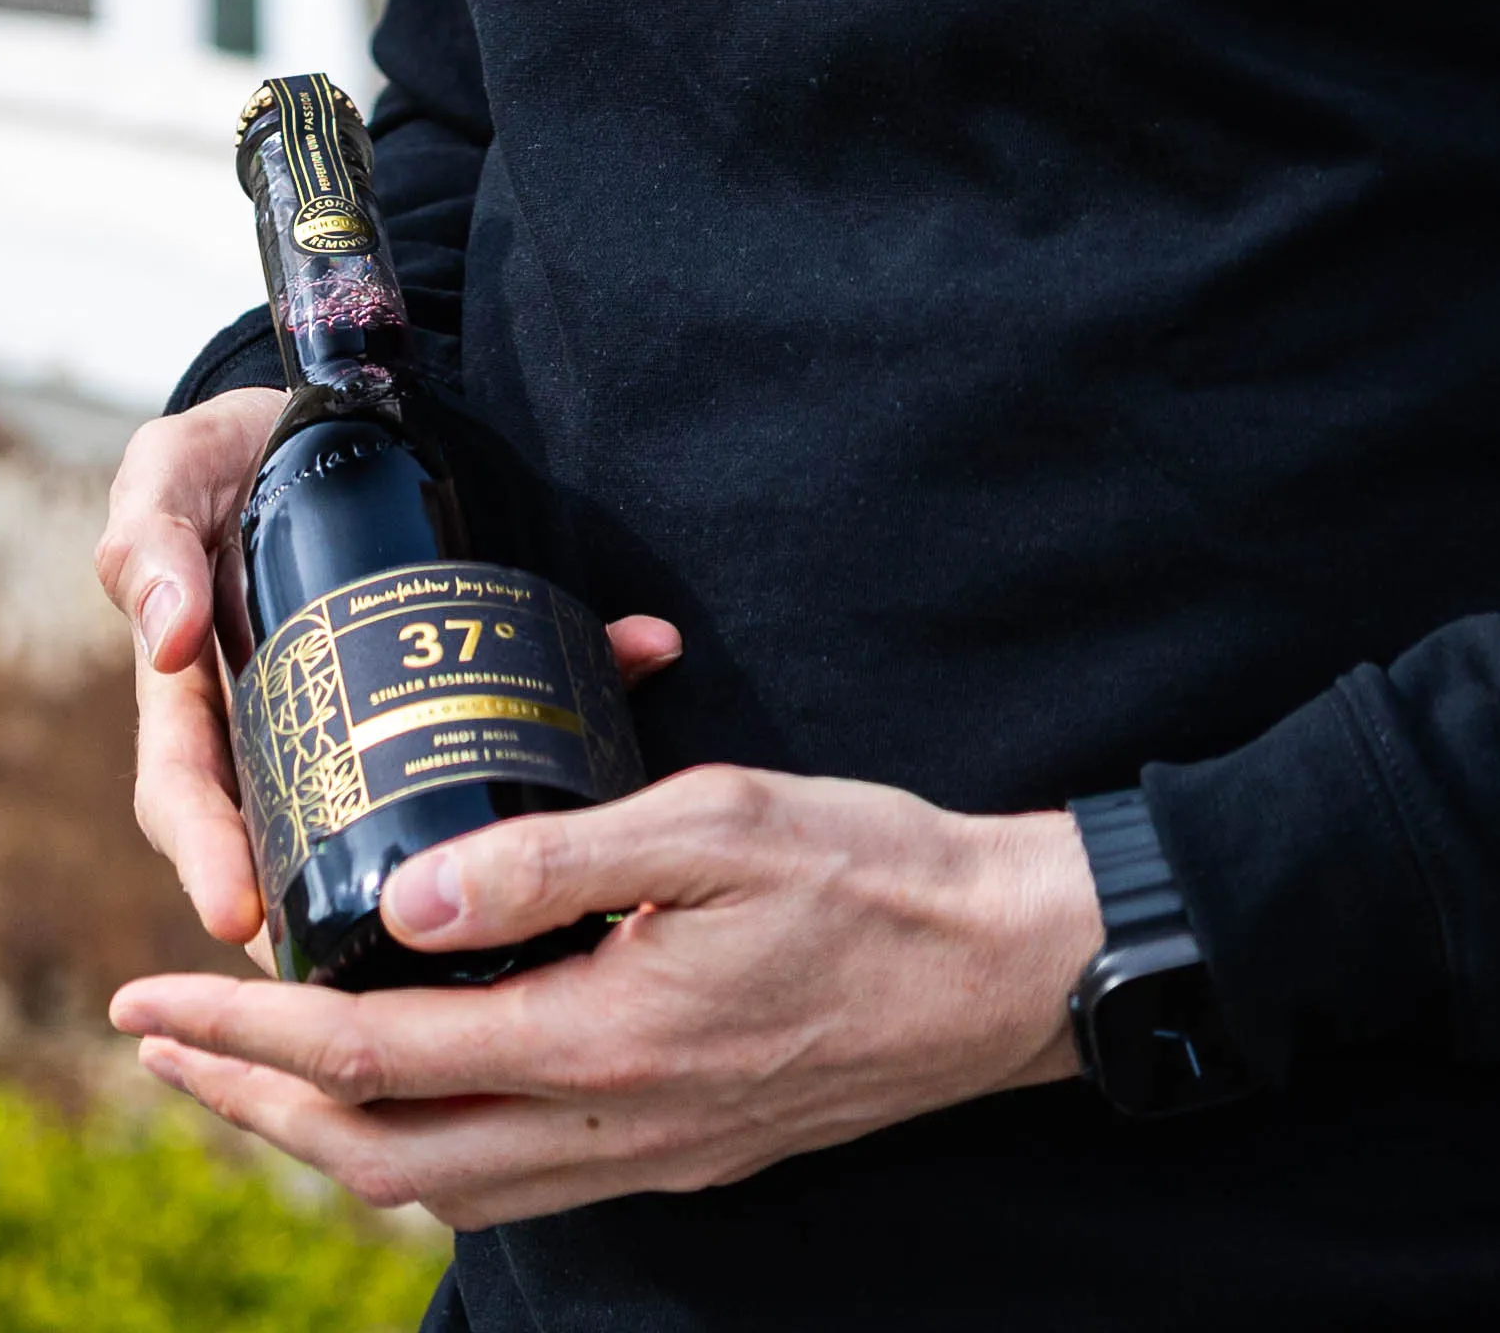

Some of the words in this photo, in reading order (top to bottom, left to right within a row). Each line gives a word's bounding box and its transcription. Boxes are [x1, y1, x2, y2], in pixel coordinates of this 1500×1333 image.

[299, 92, 315, 132] PASSION
[305, 133, 319, 151] UND
[310, 150, 332, 192] PERFEKTION
[369, 677, 425, 706] STILLER
[433, 730, 476, 746] PINOT
[405, 750, 478, 776] HIMBEERE
[495, 748, 562, 769] KIRSCH
